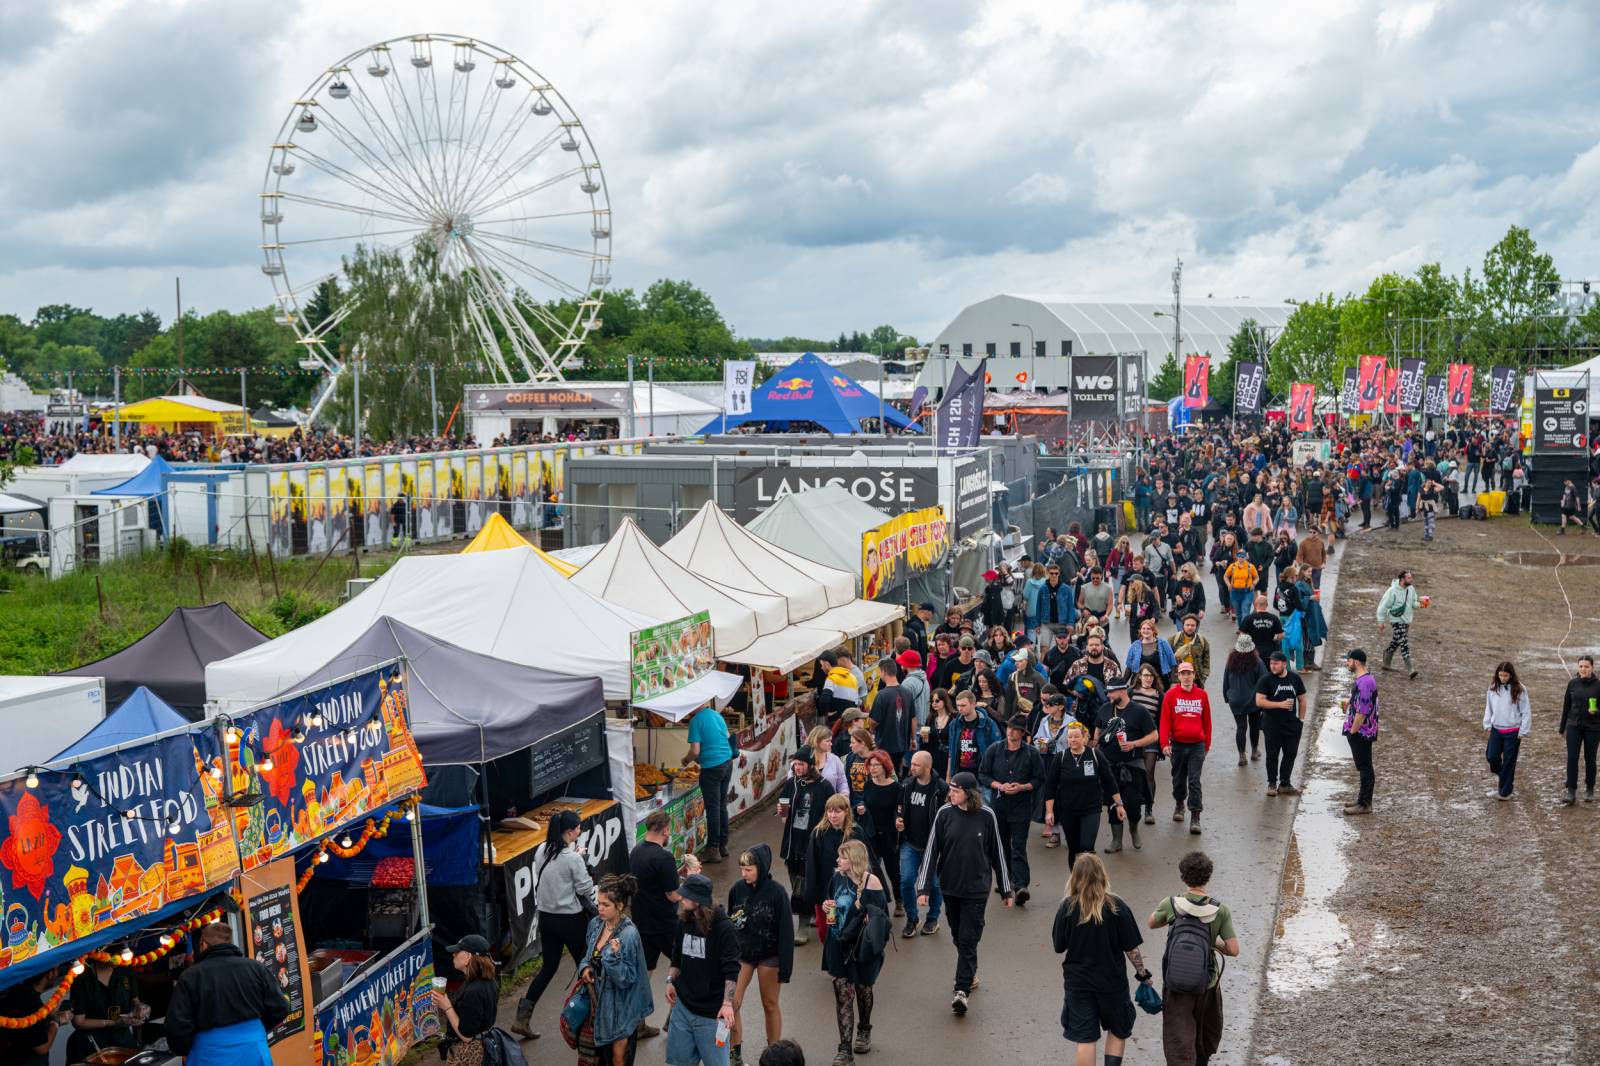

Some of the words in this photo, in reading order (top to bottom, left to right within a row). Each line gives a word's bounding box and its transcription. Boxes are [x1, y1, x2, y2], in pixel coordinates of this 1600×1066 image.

[506, 392, 545, 403] COFFEE
[768, 390, 790, 400] Red
[790, 389, 814, 399] Bull
[1075, 376, 1114, 390] WC
[1237, 375, 1248, 406] ROCK
[1247, 367, 1262, 407] PEOPLE
[1412, 362, 1425, 406] PEOPLE
[1501, 371, 1515, 410] PEOPLE
[317, 692, 363, 733] INDIAN
[302, 731, 348, 776] STREET
[351, 725, 382, 758] FOOD
[67, 803, 148, 862] STREET
[382, 958, 407, 995] STREET
